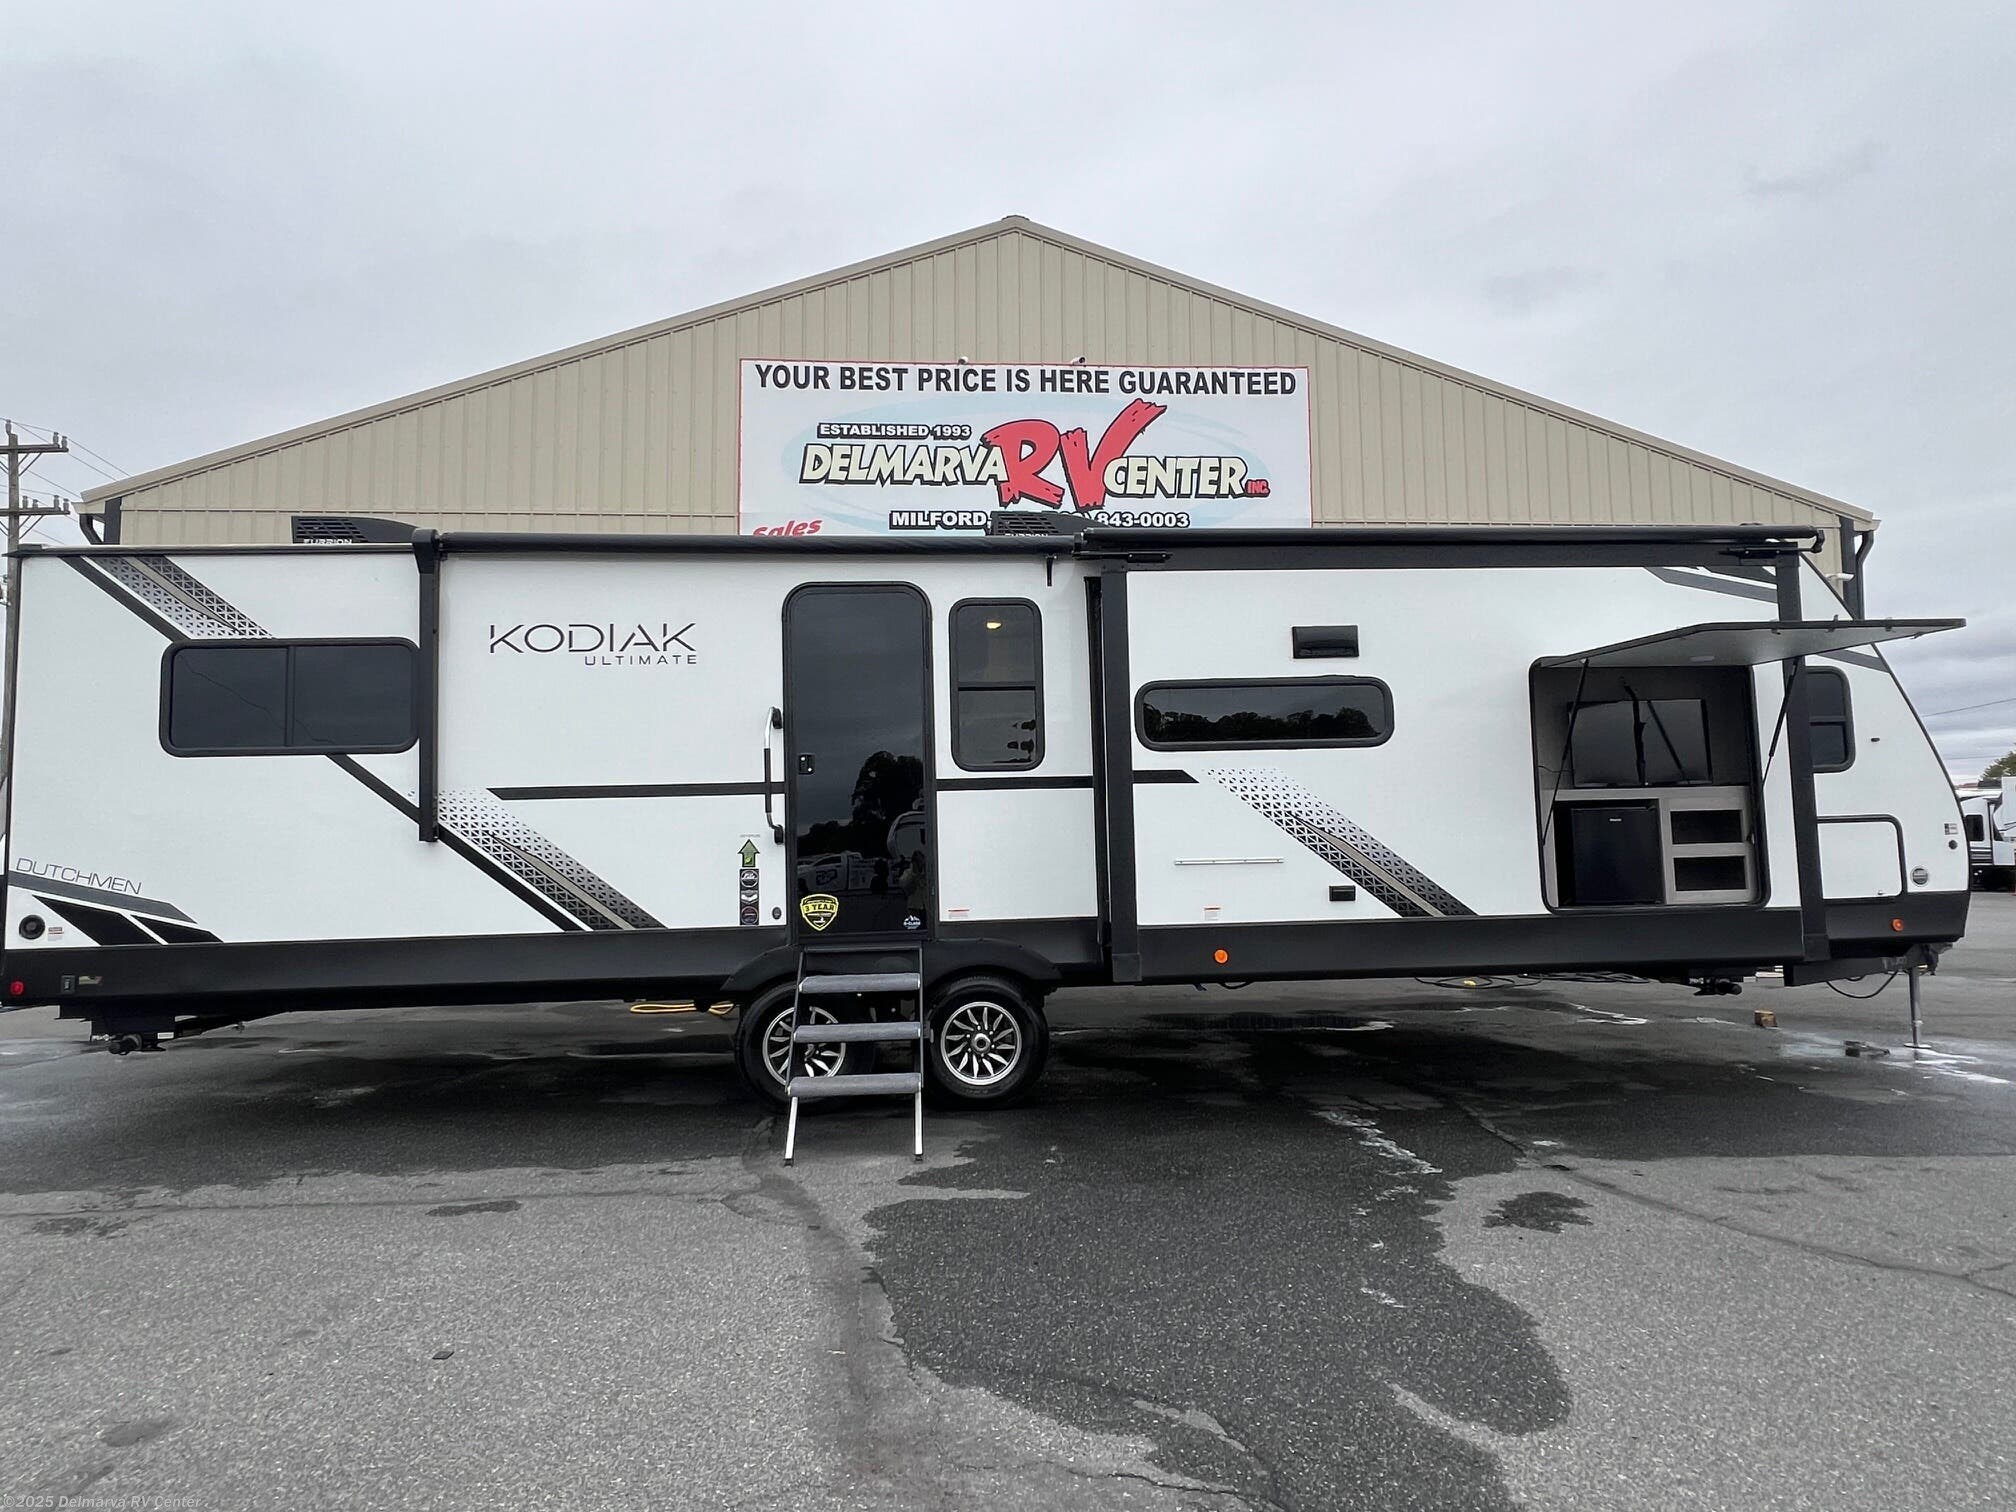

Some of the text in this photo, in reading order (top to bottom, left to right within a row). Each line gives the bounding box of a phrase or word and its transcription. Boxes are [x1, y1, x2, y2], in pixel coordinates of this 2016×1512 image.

[755, 364, 1296, 395] YOUR BEST PRICE IS HERE GUARANTEED
[819, 423, 972, 438] ESTABLISHED 1993
[800, 398, 1271, 510] DELMARVA RV CENTER INC.
[753, 519, 823, 536] sales
[1097, 511, 1190, 528] 843-0003
[489, 622, 697, 654] KODIAK
[584, 654, 697, 666] ULTIMATE
[16, 857, 142, 895] DUTCHMEN
[811, 903, 835, 911] YEAR
